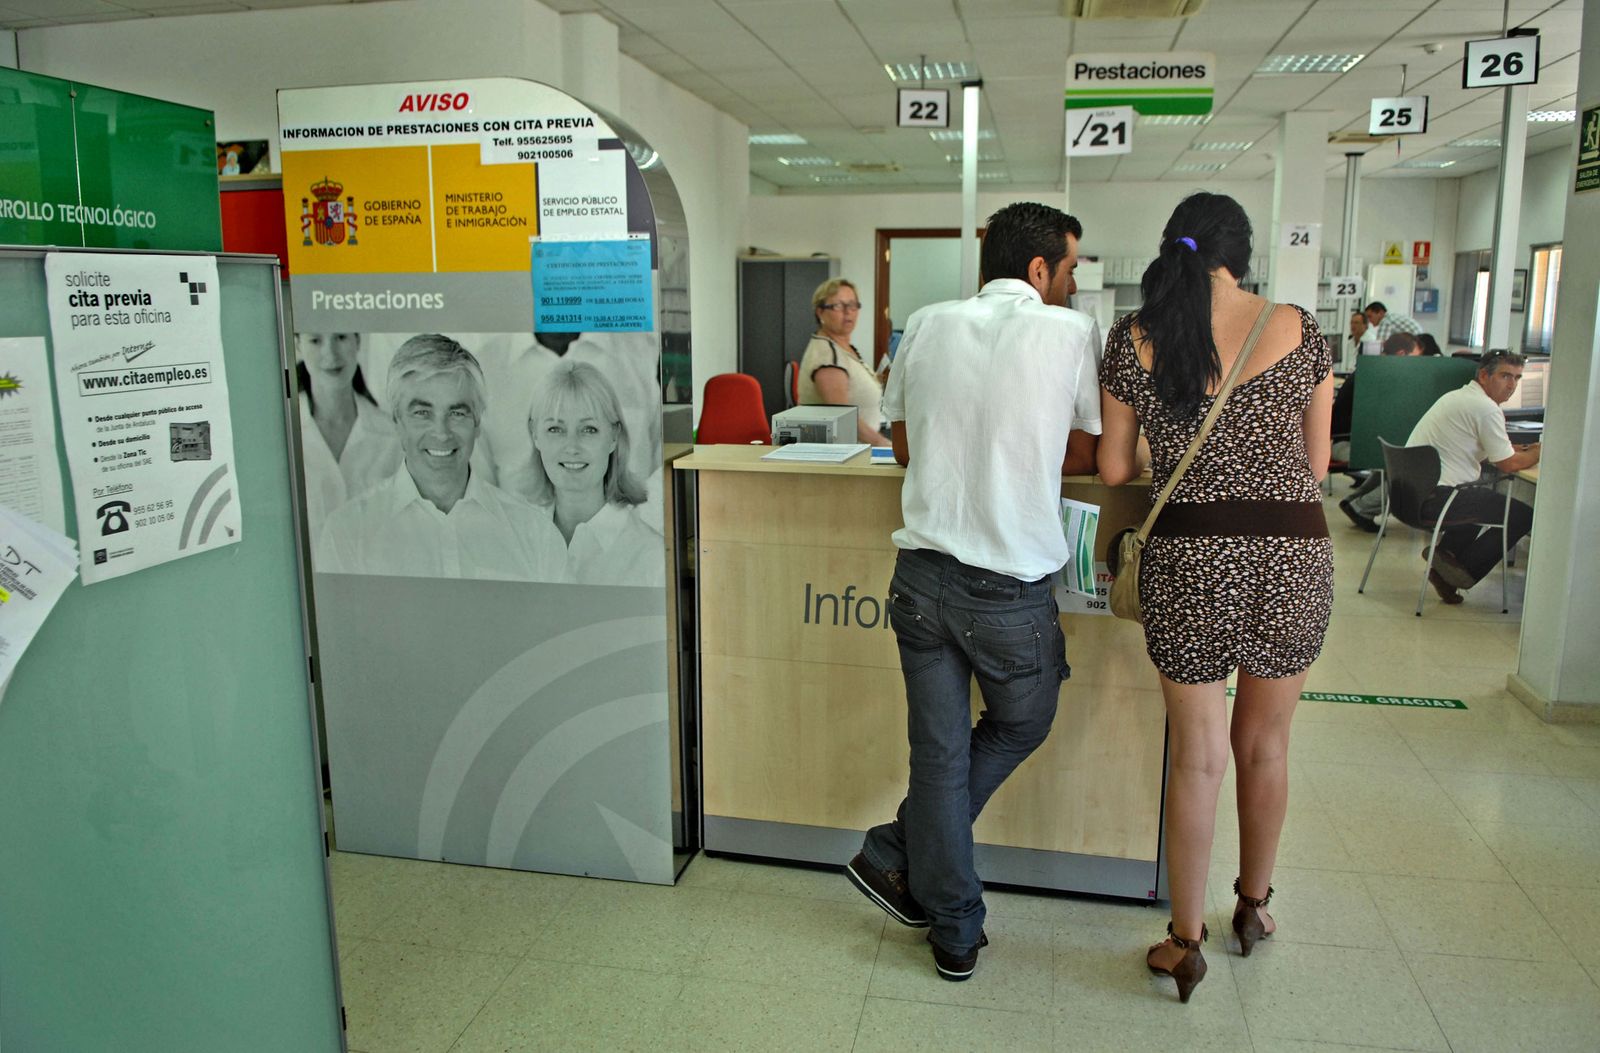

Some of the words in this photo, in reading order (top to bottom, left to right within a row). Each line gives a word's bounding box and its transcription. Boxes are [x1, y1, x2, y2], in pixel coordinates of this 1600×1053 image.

[1074, 61, 1206, 80] Prestaciones
[1480, 52, 1524, 78] 26
[399, 93, 470, 112] AVISO
[910, 101, 938, 120] 22
[1379, 108, 1412, 127] 25
[283, 127, 364, 138] INFORMACION
[368, 126, 383, 136] DE
[387, 122, 479, 135] PRESTACIONES
[483, 121, 510, 132] CON
[514, 120, 543, 130] CITA
[547, 118, 594, 129] PREVIA
[1090, 122, 1125, 147] 21
[493, 138, 514, 146] Telf.
[517, 135, 573, 146] 955625695
[518, 150, 574, 160] 902100506
[446, 193, 503, 203] MINISTERIO
[543, 197, 580, 206] SERVICIO
[582, 195, 618, 205] PÚBLICO
[364, 200, 421, 212] GOBIERNO
[446, 206, 460, 216] DE
[462, 205, 507, 216] TRABAJO
[557, 208, 588, 216] EMPLEO
[591, 207, 624, 216] ESTATAL
[58, 204, 156, 228] TECNOLÓGICO
[365, 216, 378, 226] DE
[382, 213, 422, 225] ESPAÑA
[447, 219, 452, 228] E
[455, 216, 527, 228] INMIGRACIÓN
[1290, 232, 1310, 246] 24
[65, 271, 111, 287] solicite
[1337, 283, 1356, 295] 23
[68, 290, 100, 308] cita
[104, 289, 152, 310] previa
[312, 290, 444, 310] Prestaciones
[72, 313, 101, 330] para
[104, 310, 130, 326] esta
[134, 308, 172, 324] oficina
[83, 367, 208, 390] www.citaempleo.es
[94, 415, 114, 423] Desde
[98, 439, 116, 448] Desde
[93, 488, 104, 496] Por
[1096, 573, 1116, 582] ITA
[1086, 600, 1106, 610] 902
[1302, 694, 1370, 704] TURNO,
[1376, 696, 1457, 708] GRACIAS
